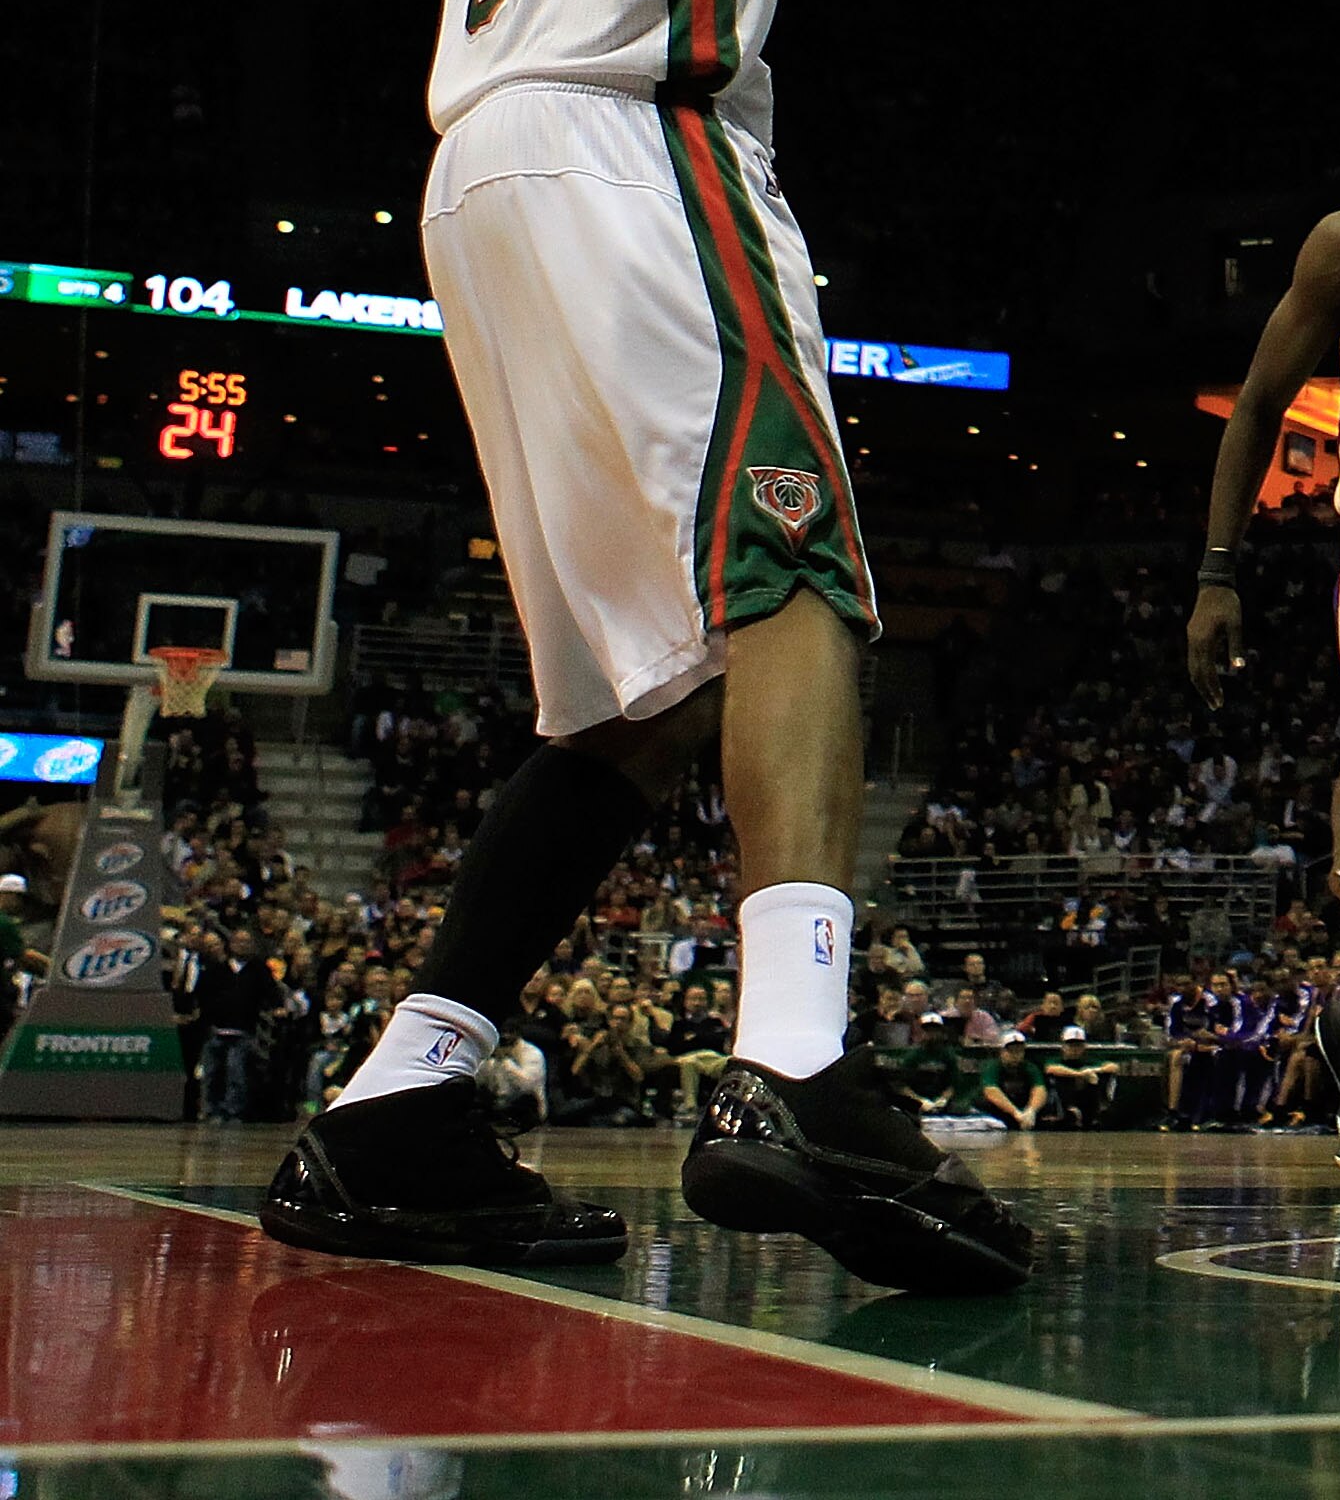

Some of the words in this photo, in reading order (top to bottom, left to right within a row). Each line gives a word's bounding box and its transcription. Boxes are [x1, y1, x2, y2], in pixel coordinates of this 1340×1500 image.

[145, 275, 235, 317] 104
[179, 370, 247, 406] 5:55
[160, 403, 237, 459] 24
[36, 1034, 151, 1053] FRONTIER
